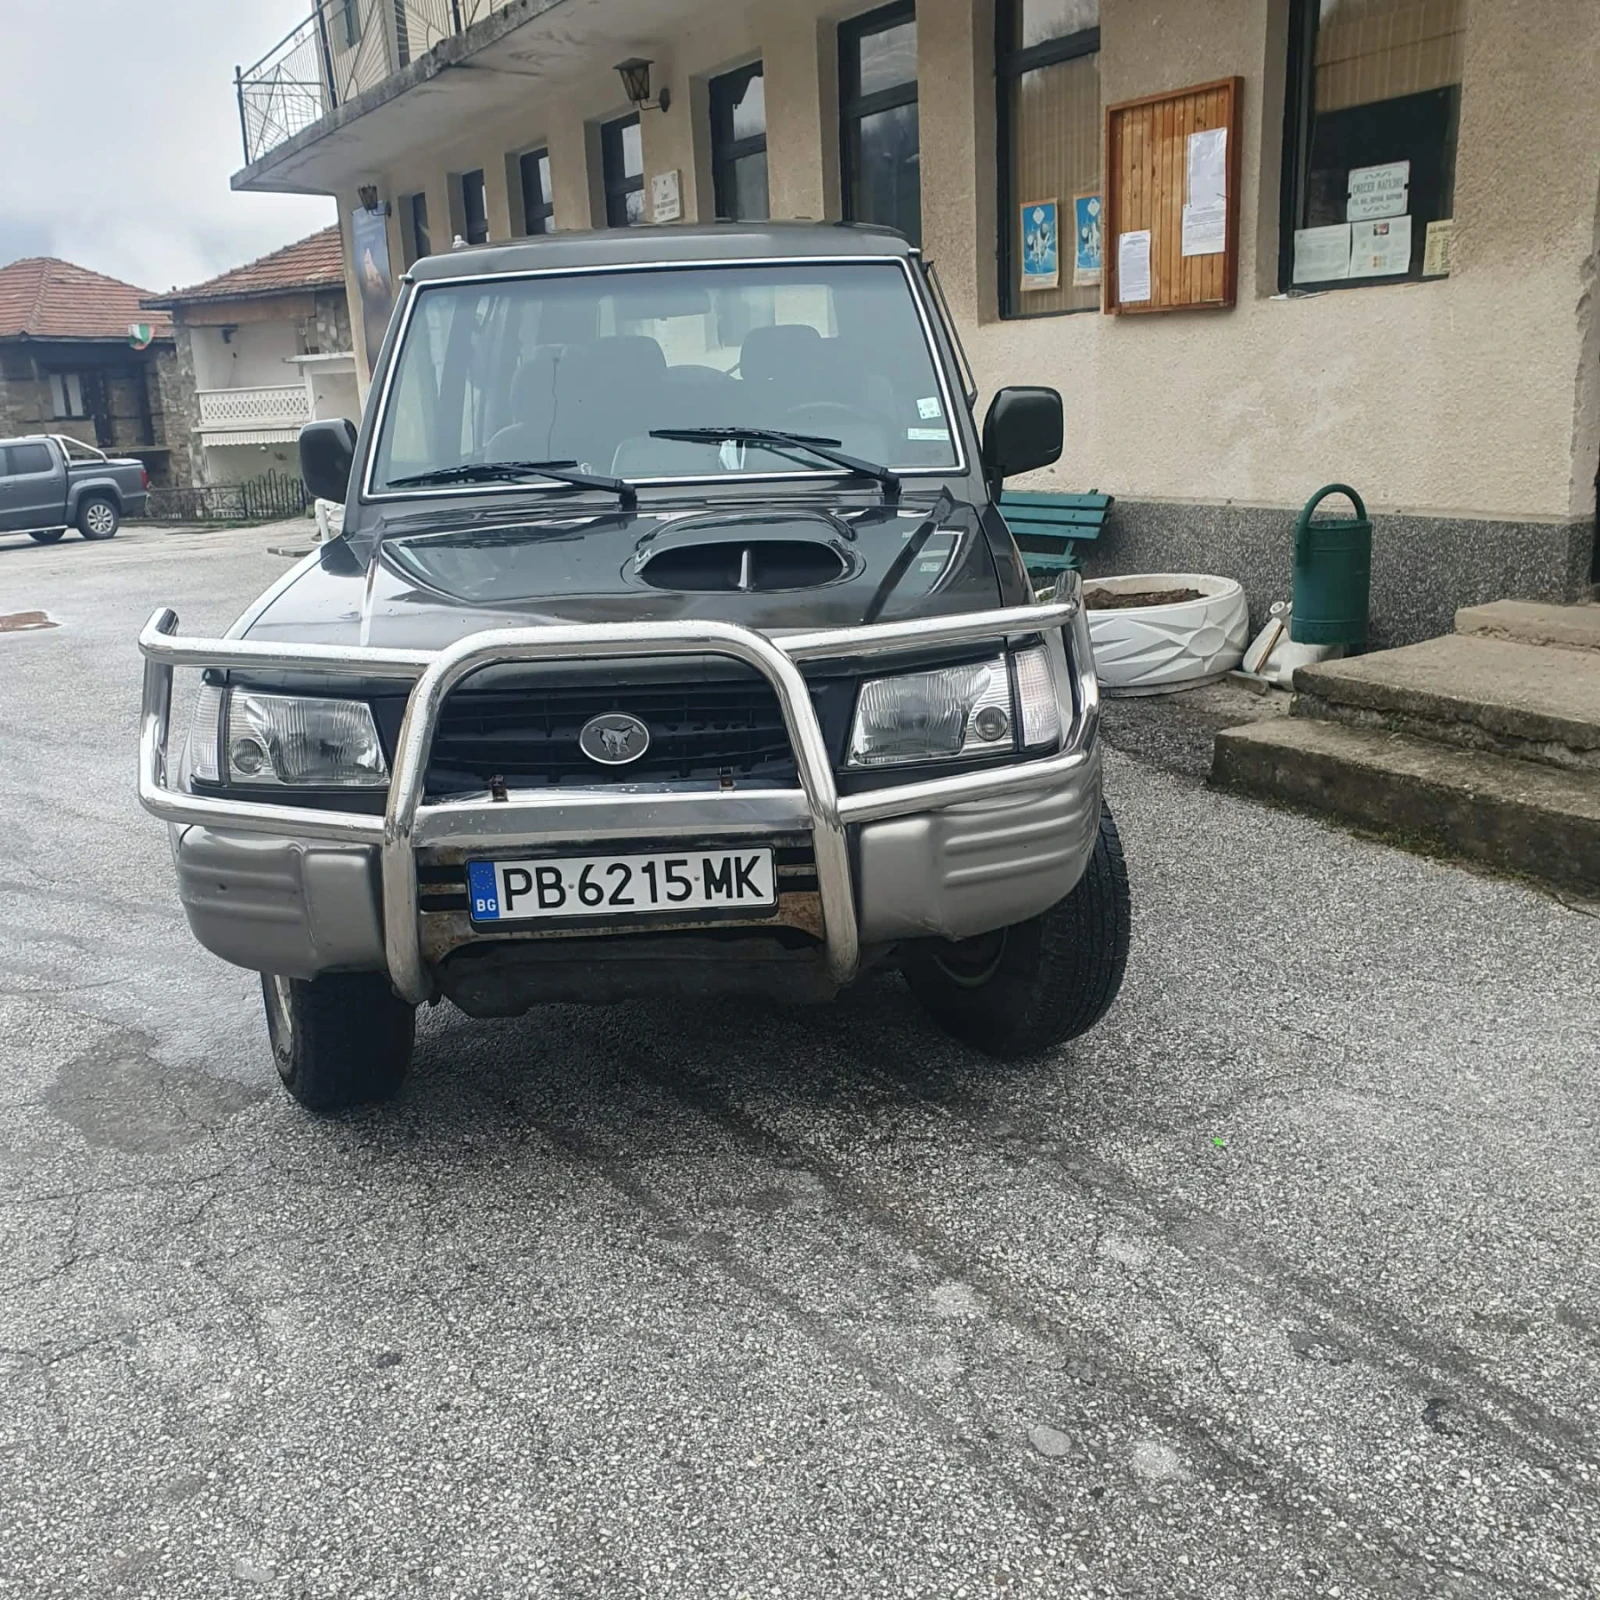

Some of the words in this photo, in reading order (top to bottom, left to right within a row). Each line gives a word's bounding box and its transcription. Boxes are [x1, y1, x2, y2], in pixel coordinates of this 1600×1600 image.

[502, 866, 567, 912] PB
[578, 859, 694, 907] 6215
[703, 855, 764, 901] MK
[476, 898, 496, 912] BG
